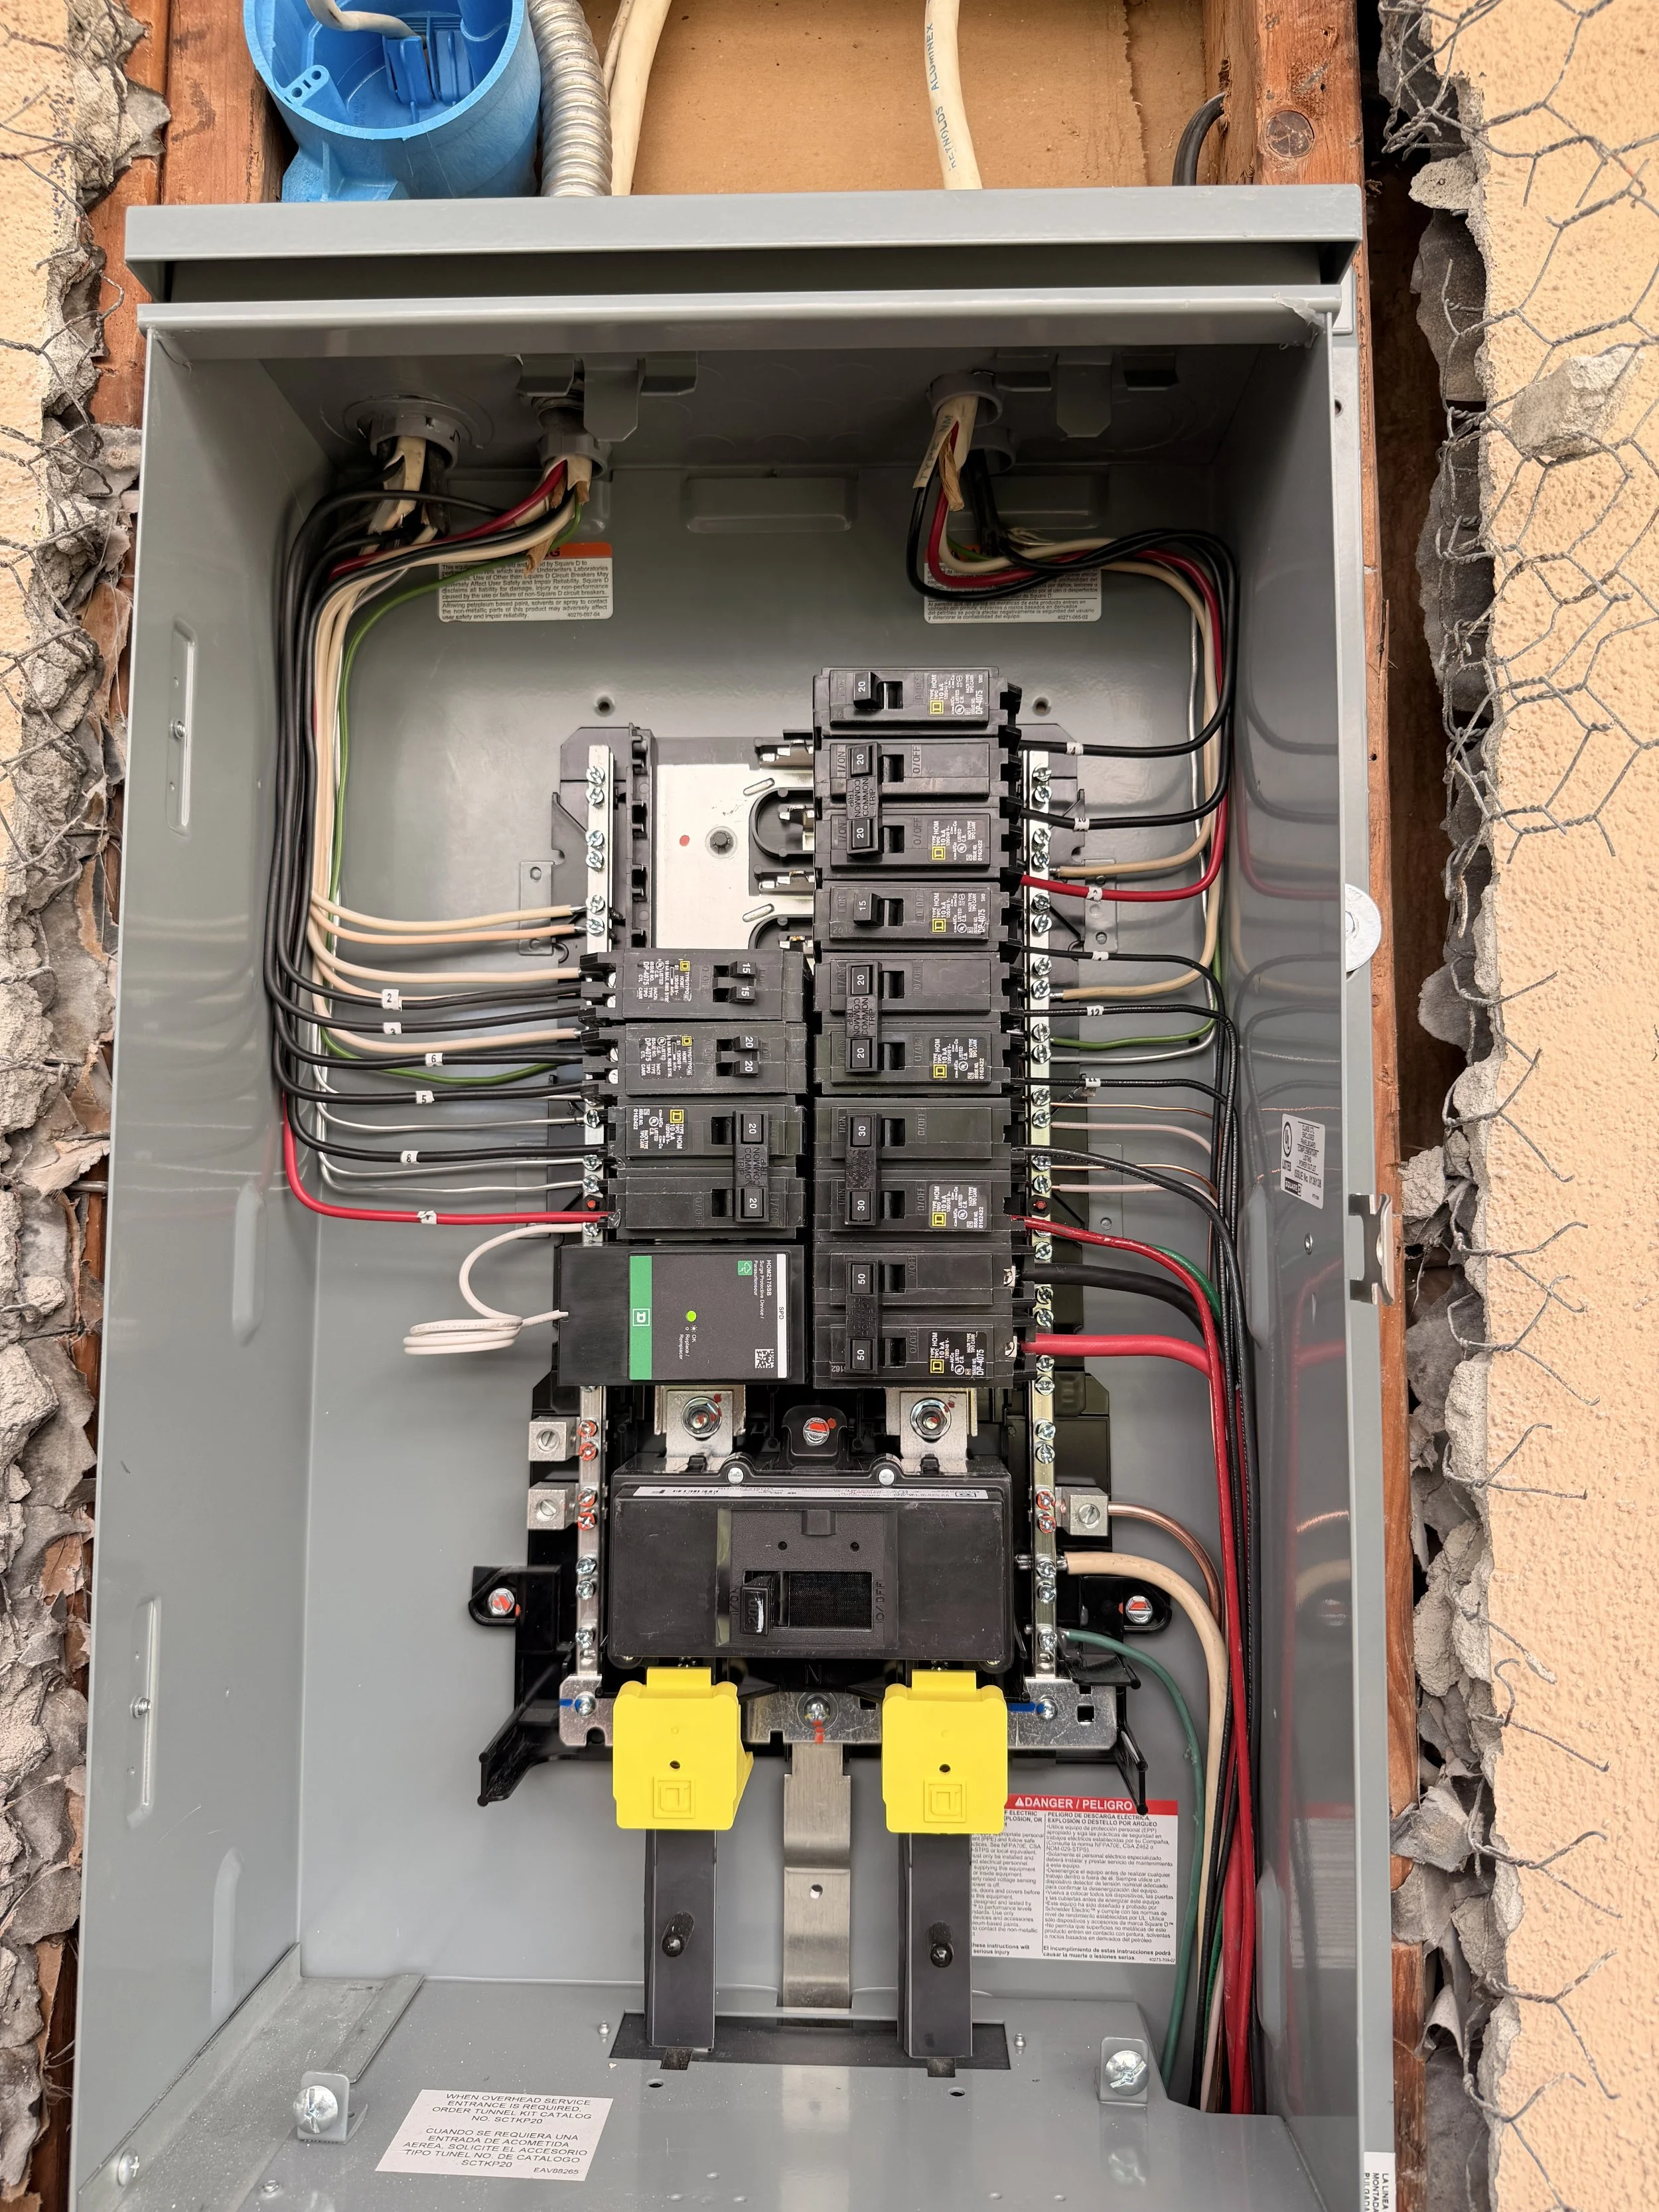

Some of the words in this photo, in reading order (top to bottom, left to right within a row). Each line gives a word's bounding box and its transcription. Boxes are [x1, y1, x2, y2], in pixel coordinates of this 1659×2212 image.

[926, 23, 939, 90] ALUMINEX
[939, 415, 954, 431] NM
[857, 681, 865, 692] 20
[1070, 745, 1076, 755] 4
[857, 753, 864, 765] 20
[857, 827, 864, 839] 20
[859, 900, 867, 911] 15
[743, 962, 751, 974] 15
[857, 974, 865, 986] 20
[741, 986, 749, 997] 15
[386, 993, 392, 1003] 2
[1090, 1008, 1099, 1017] 12
[745, 1037, 753, 1048] 20
[431, 1054, 437, 1063] 6
[857, 1047, 865, 1059] 20
[745, 1061, 753, 1072] 20
[421, 1094, 427, 1104] 5
[748, 1122, 756, 1134] 20
[858, 1125, 866, 1137] 30
[406, 1153, 411, 1163] 8
[1294, 1169, 1303, 1181] ISSUE
[749, 1197, 757, 1209] 20
[857, 1199, 865, 1211] 30
[858, 1273, 866, 1285] 50
[691, 1334, 697, 1343] OK
[857, 1349, 865, 1361] 50
[806, 1664, 822, 1684] N
[1024, 1798, 1073, 1808] DANGER
[1082, 1800, 1133, 1811] PELIGRO
[480, 2095, 541, 2104] OVERHEAD
[447, 2100, 507, 2108] ENTRANCE
[522, 2103, 581, 2113] REQUIRED,
[492, 2116, 544, 2124] SCTKP20
[539, 2111, 592, 2120] CATALOG
[492, 2130, 553, 2140] REQUIERA
[401, 2141, 445, 2150] AEREA,
[445, 2143, 500, 2152] SOLICITE
[518, 2147, 588, 2156] ACCESORIO
[501, 2138, 569, 2148] ACOMETIDA
[514, 2154, 580, 2164] CATALOGO
[1382, 2173, 1388, 2183] LA
